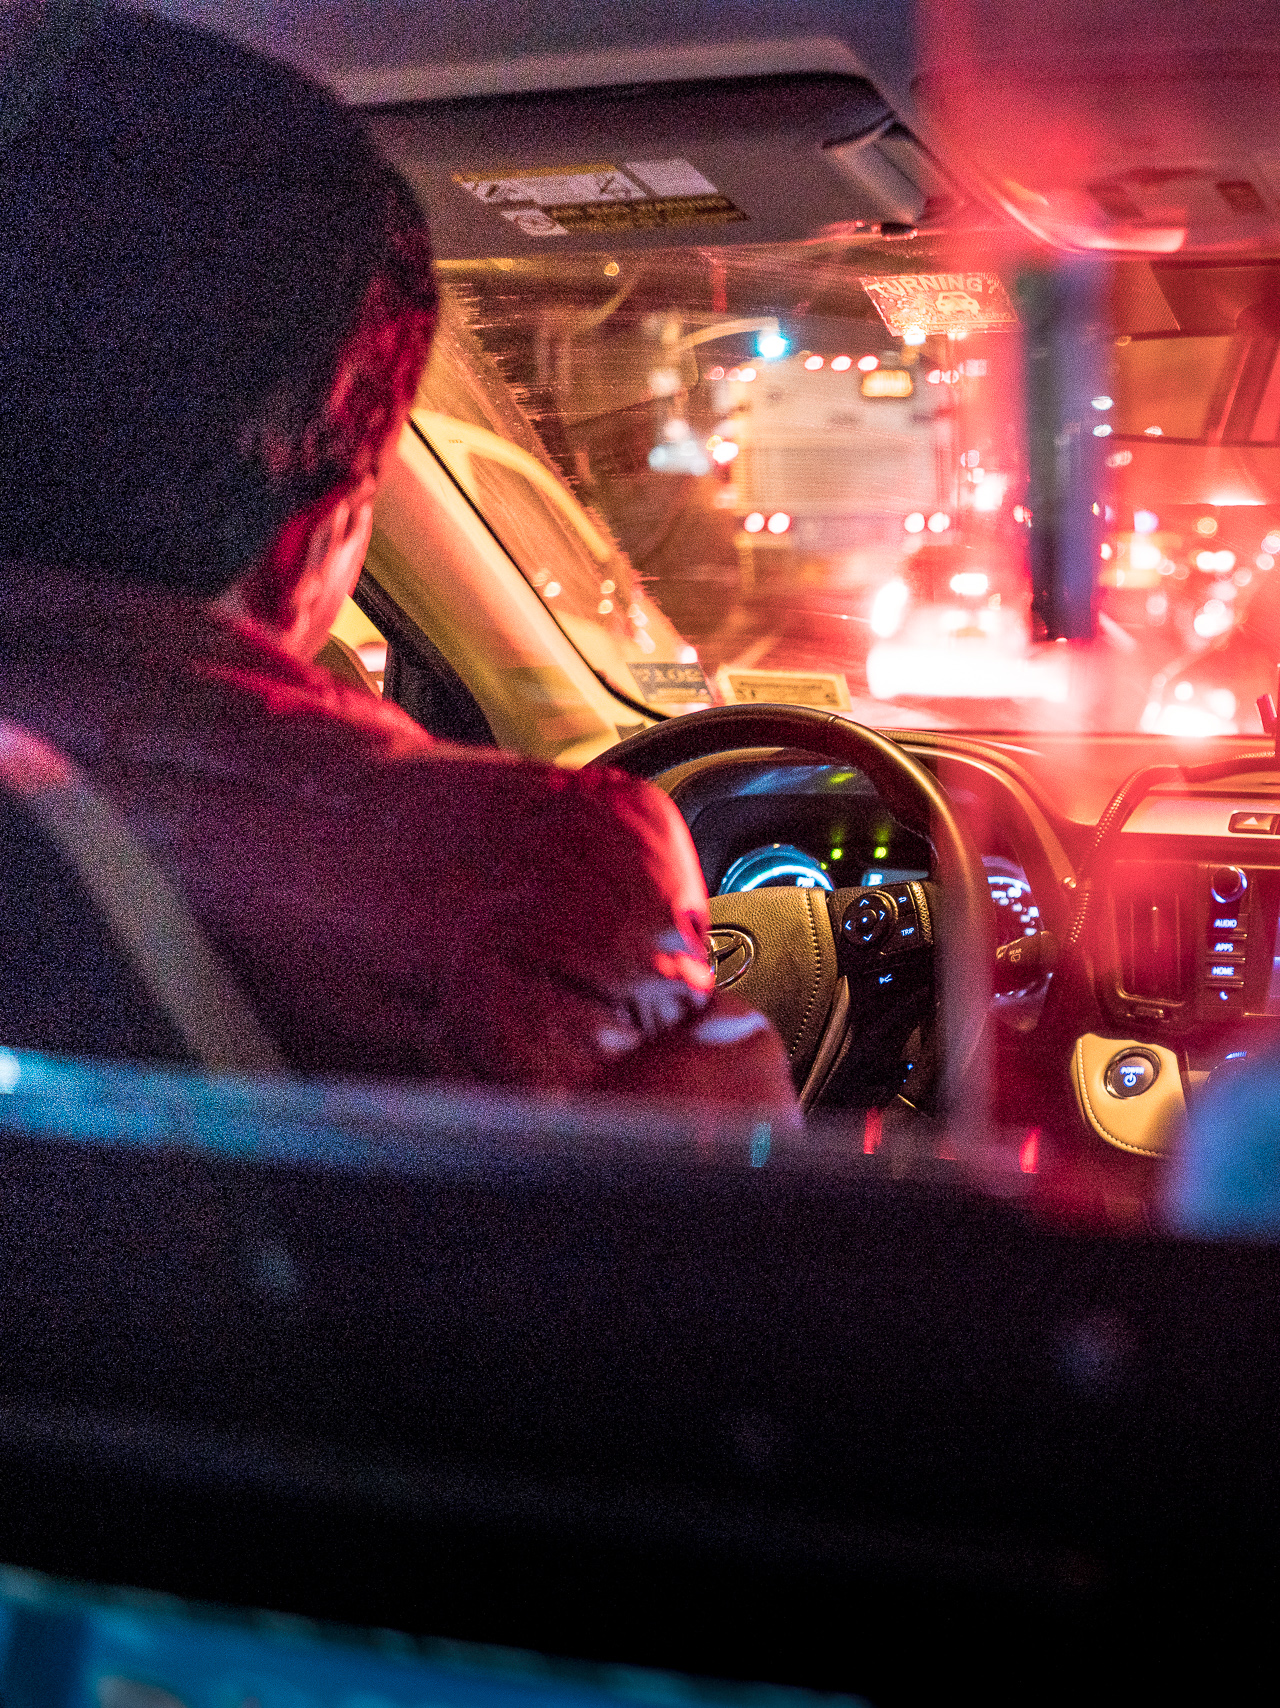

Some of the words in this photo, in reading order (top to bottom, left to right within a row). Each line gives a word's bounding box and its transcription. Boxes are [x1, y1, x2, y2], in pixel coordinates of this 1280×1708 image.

[1213, 918, 1238, 928] AUDIO
[901, 927, 915, 936] TRIP
[1214, 942, 1234, 952] APPS
[1211, 966, 1235, 976] HOME
[1120, 1065, 1145, 1075] POWER
